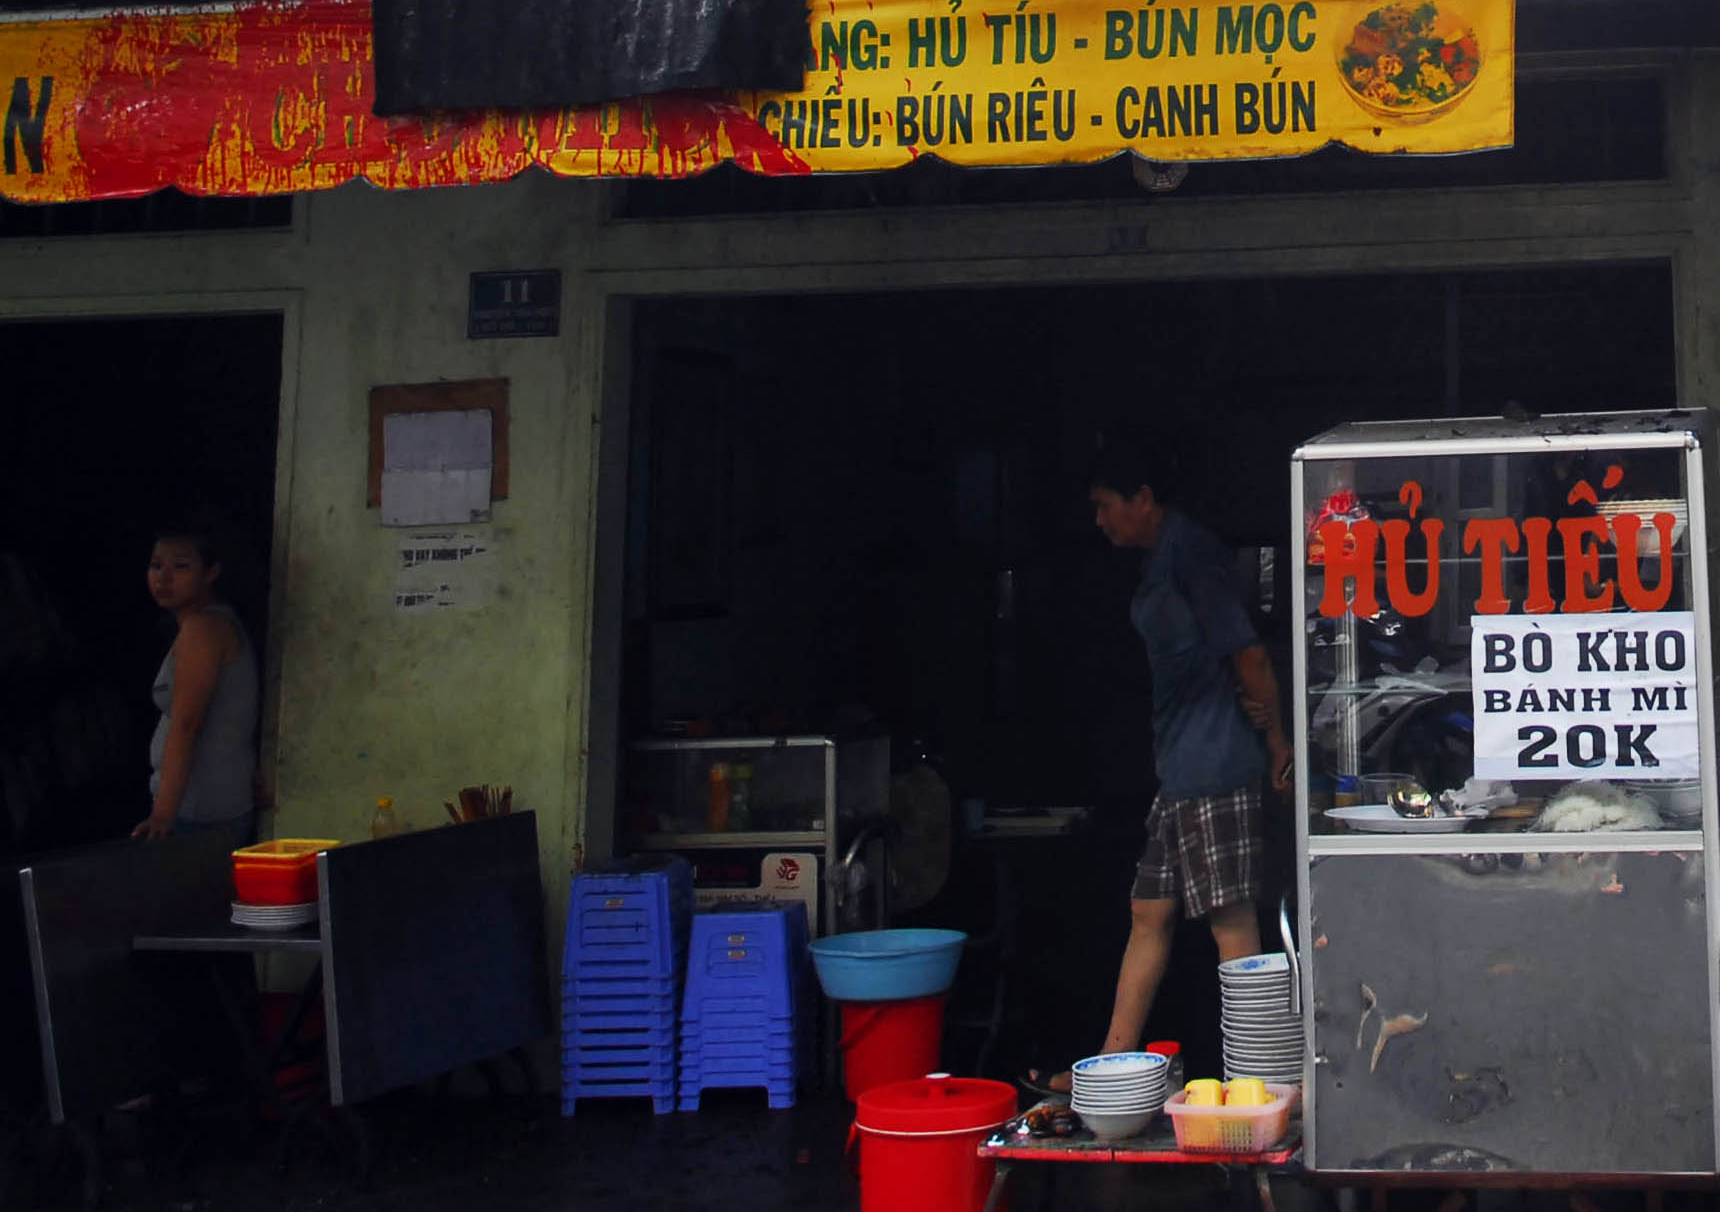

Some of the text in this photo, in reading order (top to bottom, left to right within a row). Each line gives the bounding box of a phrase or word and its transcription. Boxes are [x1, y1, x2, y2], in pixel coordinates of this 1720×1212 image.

[806, 19, 891, 72] NG:
[987, 0, 1057, 65] TÍU
[1215, 1, 1317, 65] MỌC
[758, 75, 882, 149] CHIỀU:
[896, 80, 974, 147] BÚN
[987, 77, 1076, 144] RIÊU
[1116, 84, 1219, 140] CANH
[1234, 66, 1317, 136] BÚN
[1318, 464, 1677, 619] HỦ TIẾU
[1483, 621, 1686, 674] BÒ KHO
[1631, 680, 1688, 712] MÌ
[1517, 724, 1661, 769] 20K
